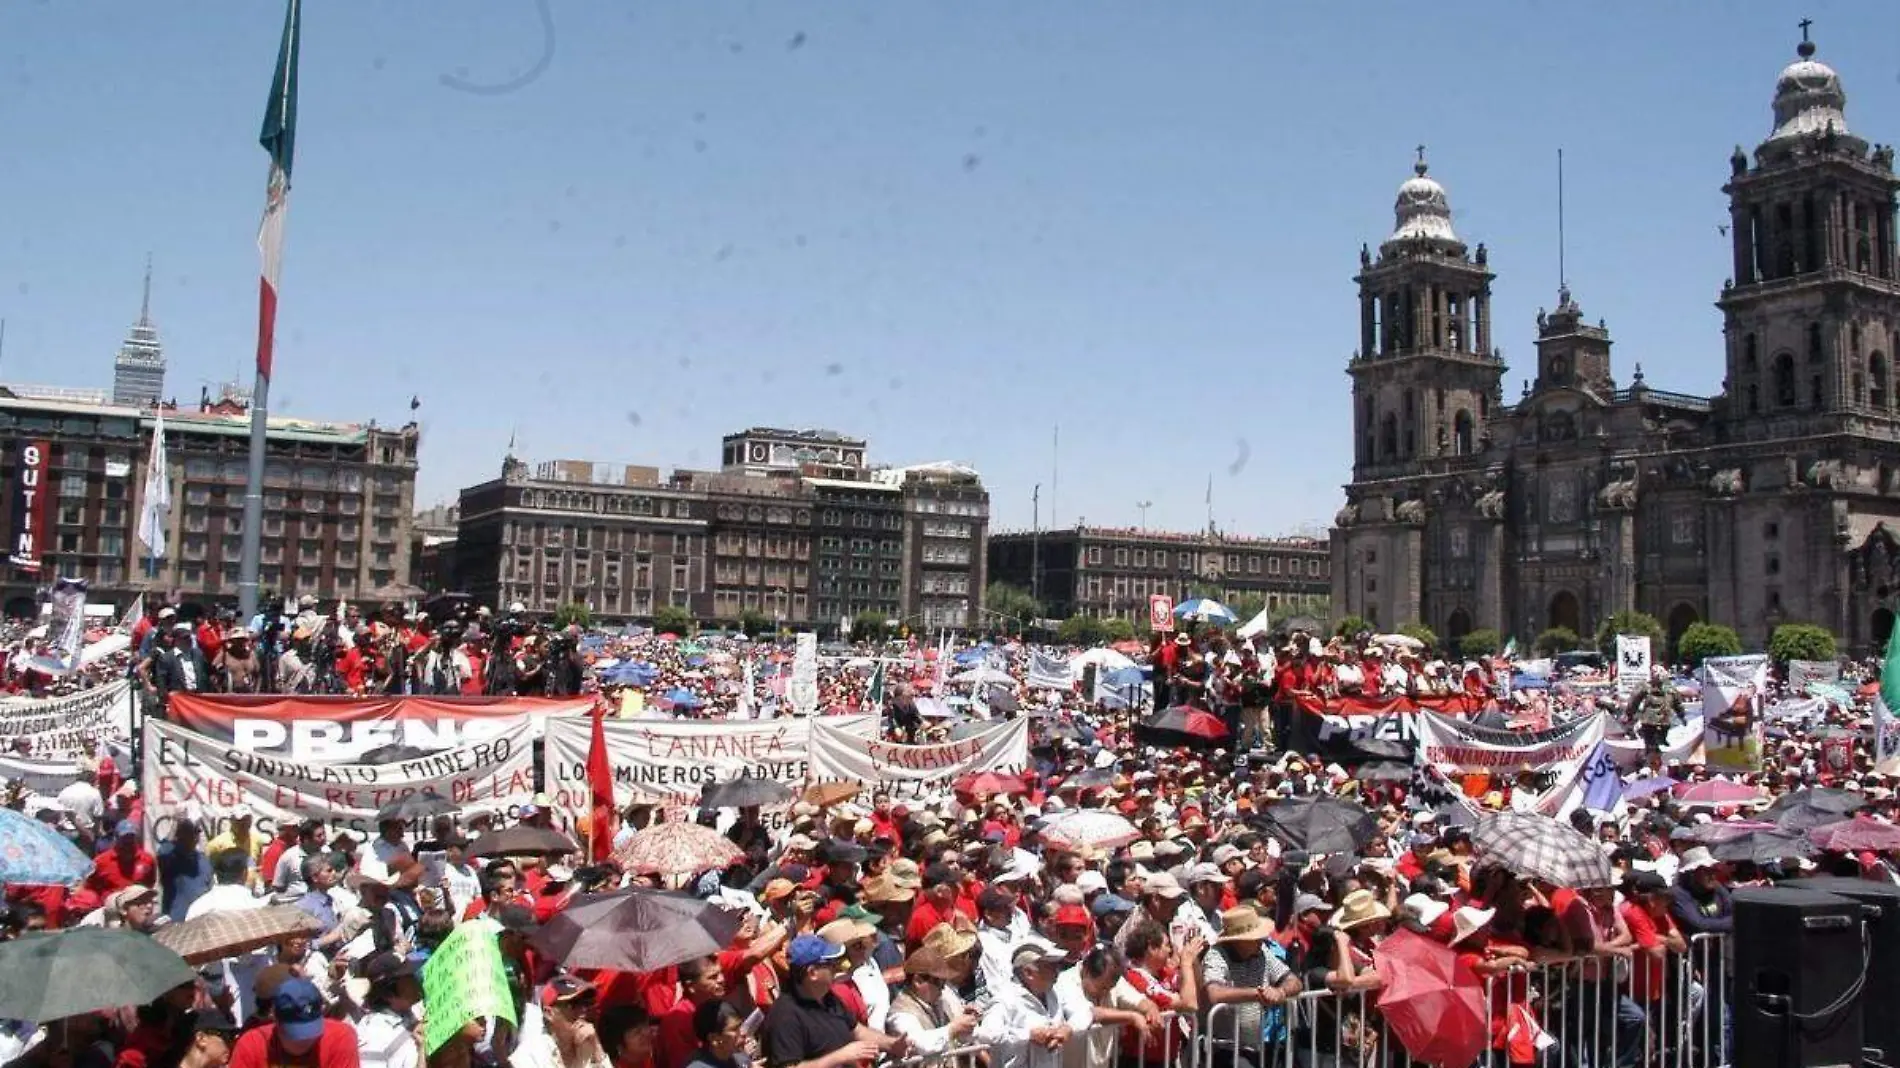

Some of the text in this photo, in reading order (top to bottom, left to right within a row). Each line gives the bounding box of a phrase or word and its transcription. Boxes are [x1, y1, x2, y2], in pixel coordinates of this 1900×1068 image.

[18, 446, 40, 551] SUTIN
[160, 737, 200, 766] EL
[402, 738, 511, 779] MINERO
[560, 762, 586, 781] LO
[616, 762, 717, 784] MINEROS
[159, 776, 249, 808] EXIGE
[275, 784, 308, 809] EL
[452, 779, 478, 805] DE
